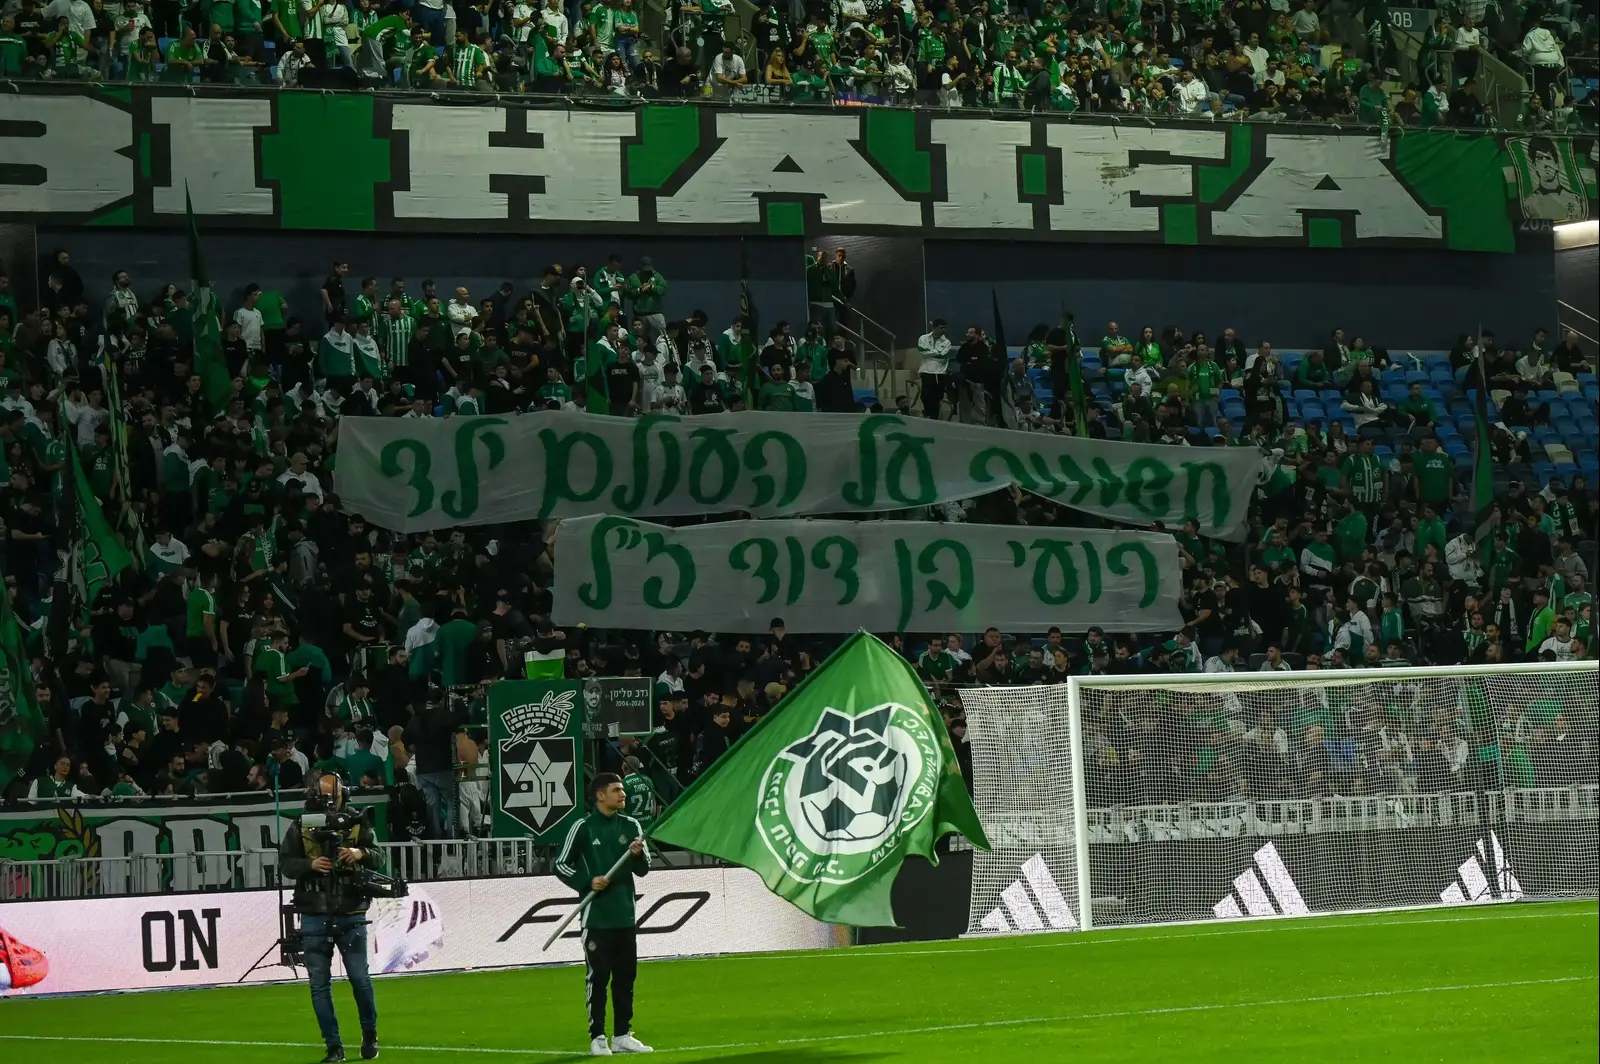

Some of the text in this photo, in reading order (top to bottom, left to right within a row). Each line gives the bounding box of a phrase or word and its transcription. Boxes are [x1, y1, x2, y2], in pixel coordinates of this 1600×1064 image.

[390, 103, 1443, 240] HAIFA
[380, 417, 509, 520] ילד
[537, 414, 807, 520] העולם
[842, 414, 938, 508] על
[728, 535, 859, 606] דוד
[894, 537, 974, 633] בן
[140, 907, 221, 973] ON
